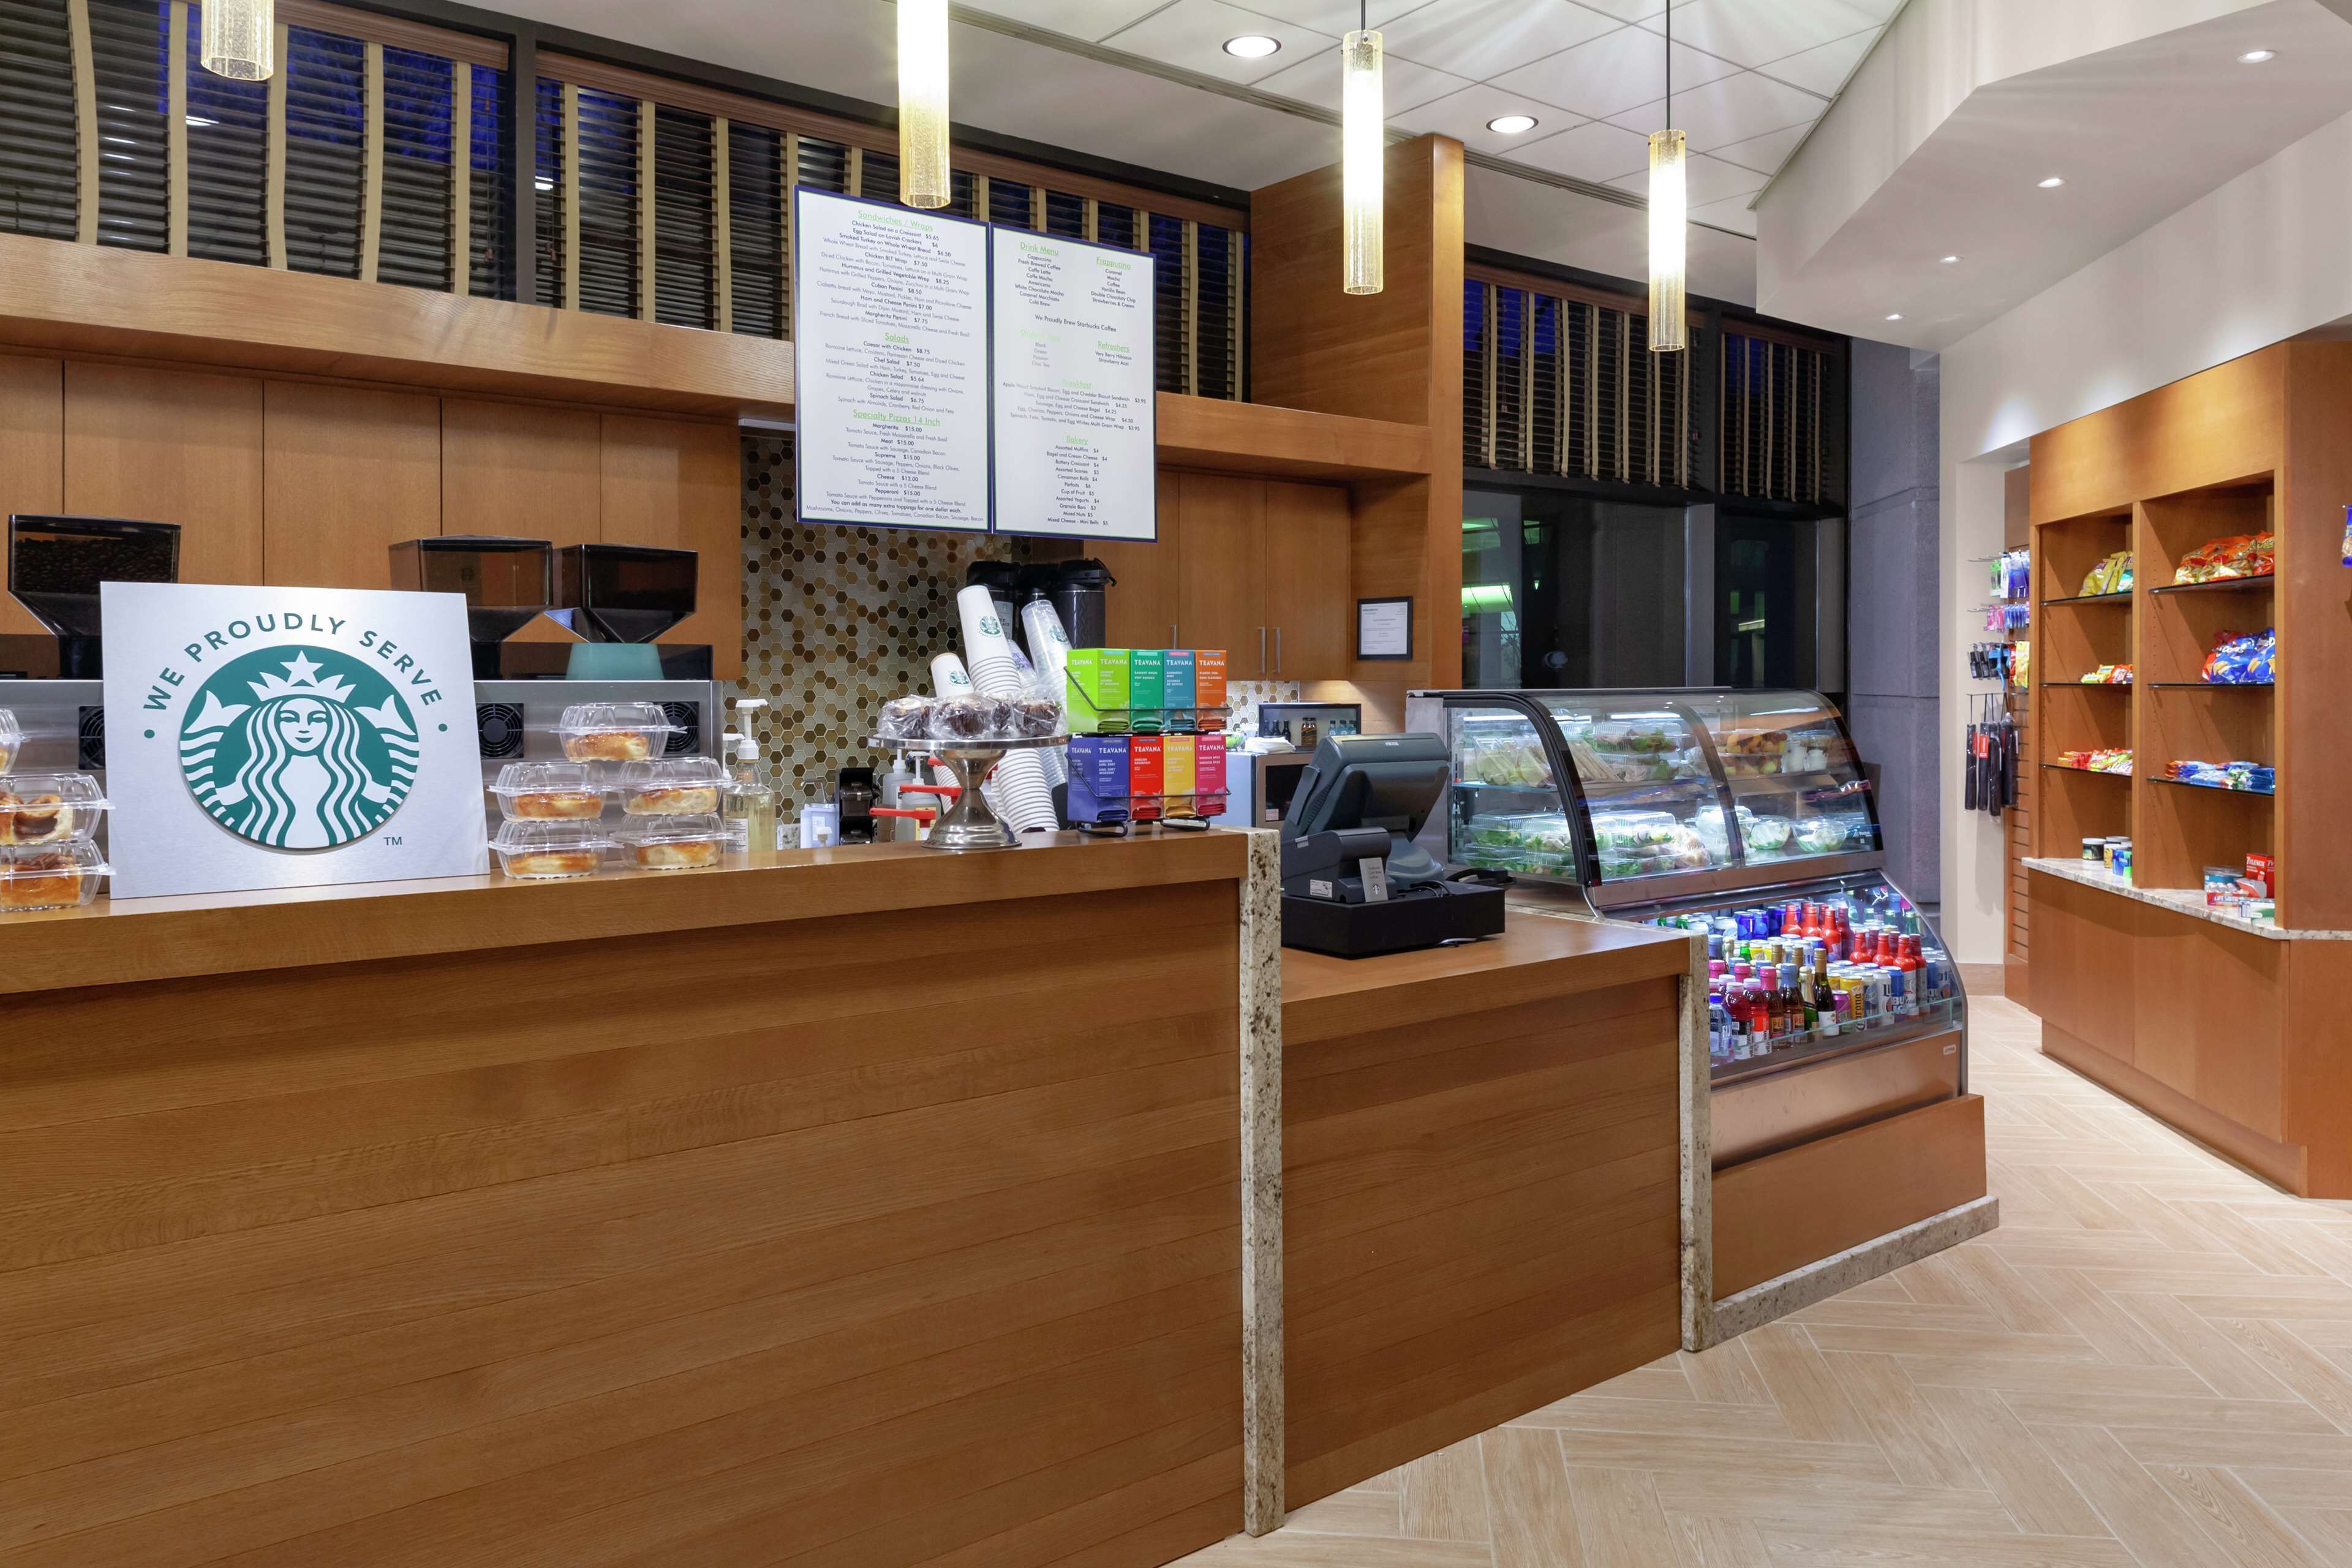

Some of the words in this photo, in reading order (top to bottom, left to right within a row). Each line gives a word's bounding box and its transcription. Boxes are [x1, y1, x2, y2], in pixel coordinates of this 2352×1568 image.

[858, 210, 902, 225] Sandwiches
[910, 220, 933, 232] Wraps
[899, 230, 921, 238] Croissant
[861, 236, 876, 245] Turkey
[902, 237, 922, 246] Crackers
[1020, 241, 1039, 251] Drink
[1040, 245, 1059, 255] Menu
[1027, 254, 1052, 263] Cappuccino
[892, 271, 916, 280] Vegetable
[1028, 279, 1050, 288] Americano
[1092, 297, 1117, 306] Strawberries
[1044, 315, 1063, 325] Proudly
[1077, 321, 1100, 330] Starbucks
[884, 333, 909, 342] Salads
[1098, 341, 1130, 352] Refreshers
[1098, 357, 1120, 366] Strawberry
[853, 409, 886, 421] Specialty
[889, 413, 911, 422] Pizzas
[1066, 435, 1088, 445] Bakery
[143, 667, 186, 710] WE
[184, 612, 346, 663] PROUDLY
[359, 630, 443, 706] SERVE
[383, 837, 402, 845] TM
